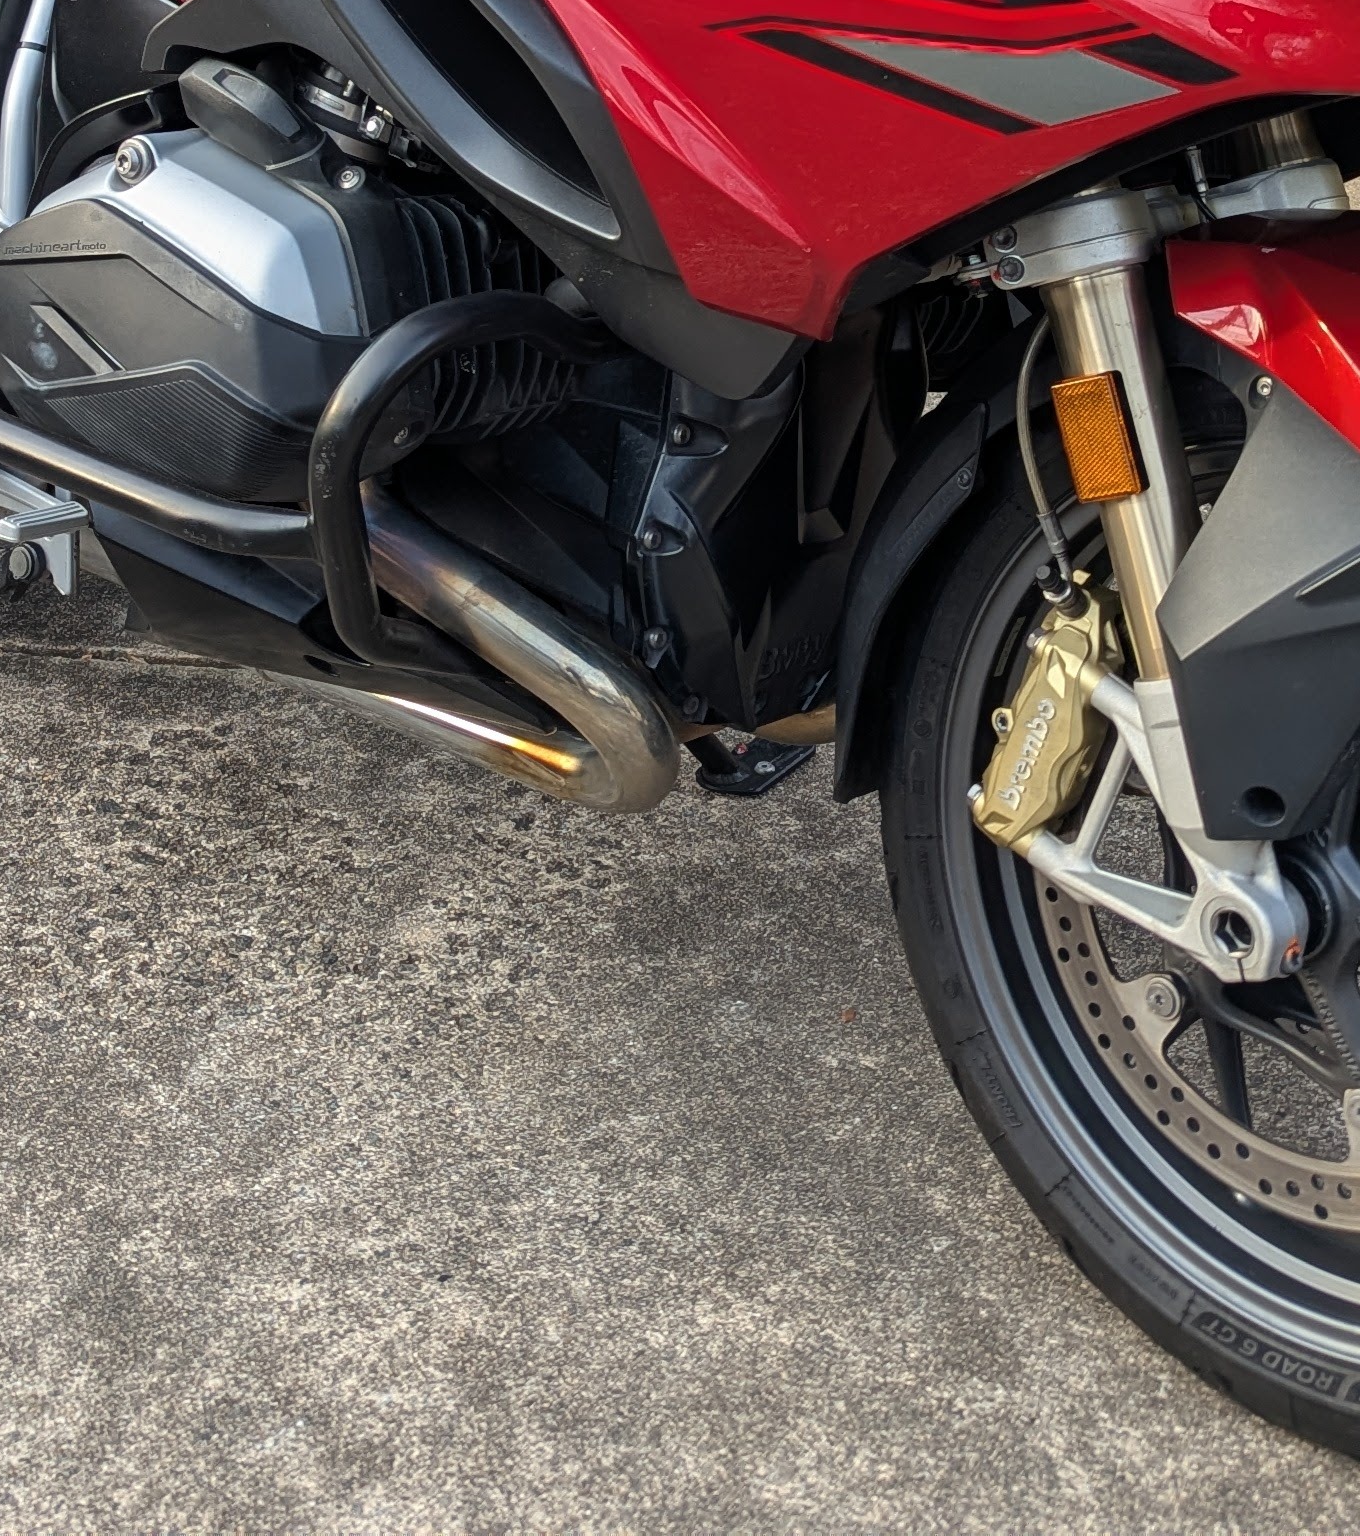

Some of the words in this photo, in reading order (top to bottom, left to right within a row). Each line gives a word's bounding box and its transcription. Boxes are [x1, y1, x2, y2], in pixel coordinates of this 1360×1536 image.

[998, 697, 1055, 811] brembo
[1201, 1316, 1238, 1344] GT
[1238, 1337, 1259, 1356] 6
[1261, 1350, 1337, 1392] ROAD
